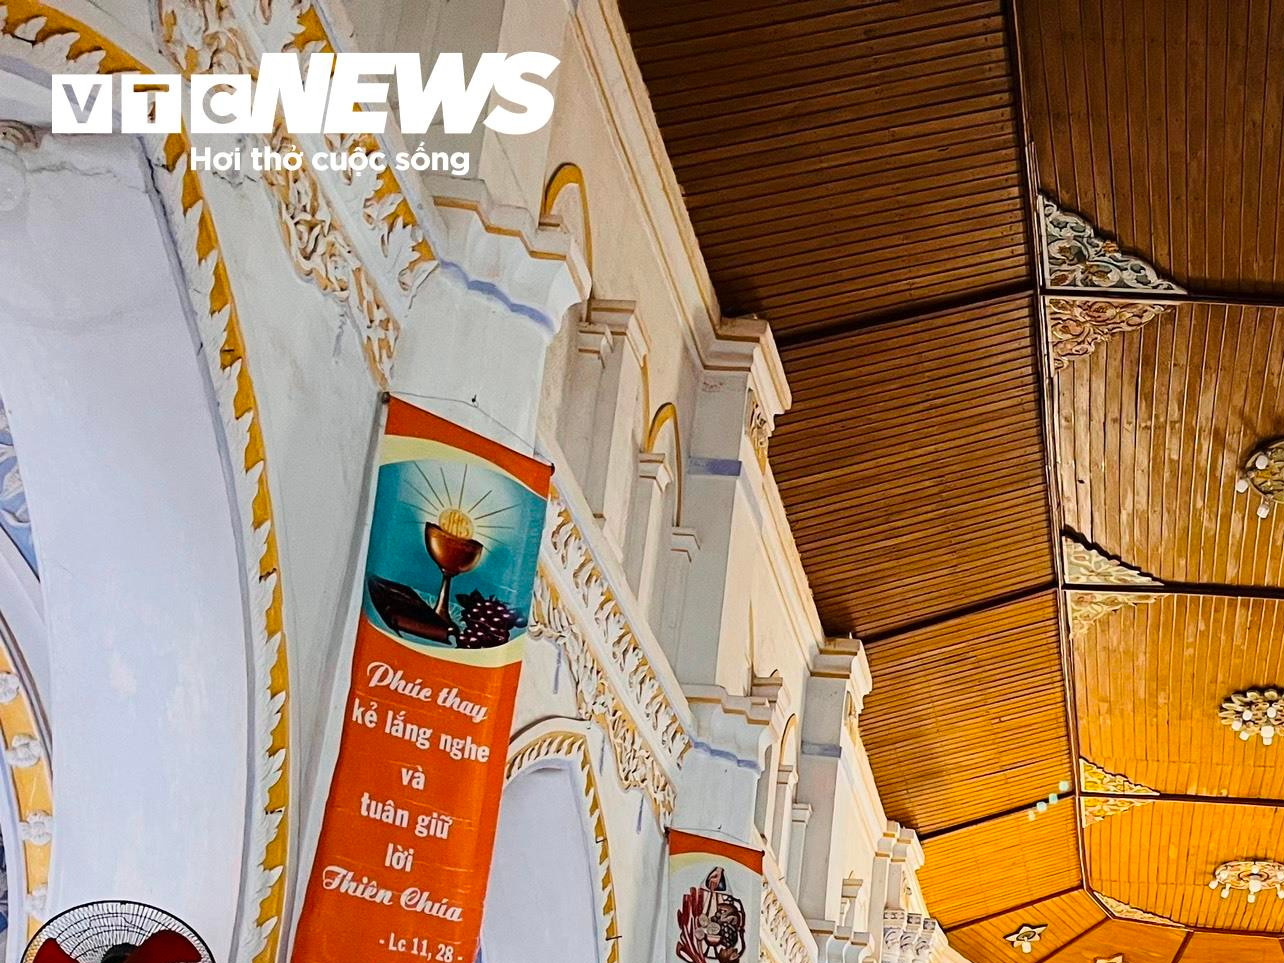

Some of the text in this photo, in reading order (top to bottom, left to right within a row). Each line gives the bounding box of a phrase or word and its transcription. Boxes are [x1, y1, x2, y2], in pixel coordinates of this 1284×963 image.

[367, 661, 489, 723] Phúc thay
[352, 698, 490, 764] kẻ lắng nghe
[400, 767, 426, 791] và
[360, 792, 453, 841] tuân giữ
[385, 843, 413, 872] lời
[322, 865, 463, 923] Thiên Chúa
[388, 932, 406, 953] Lc
[411, 937, 432, 960] 11,
[436, 943, 453, 963] 28
